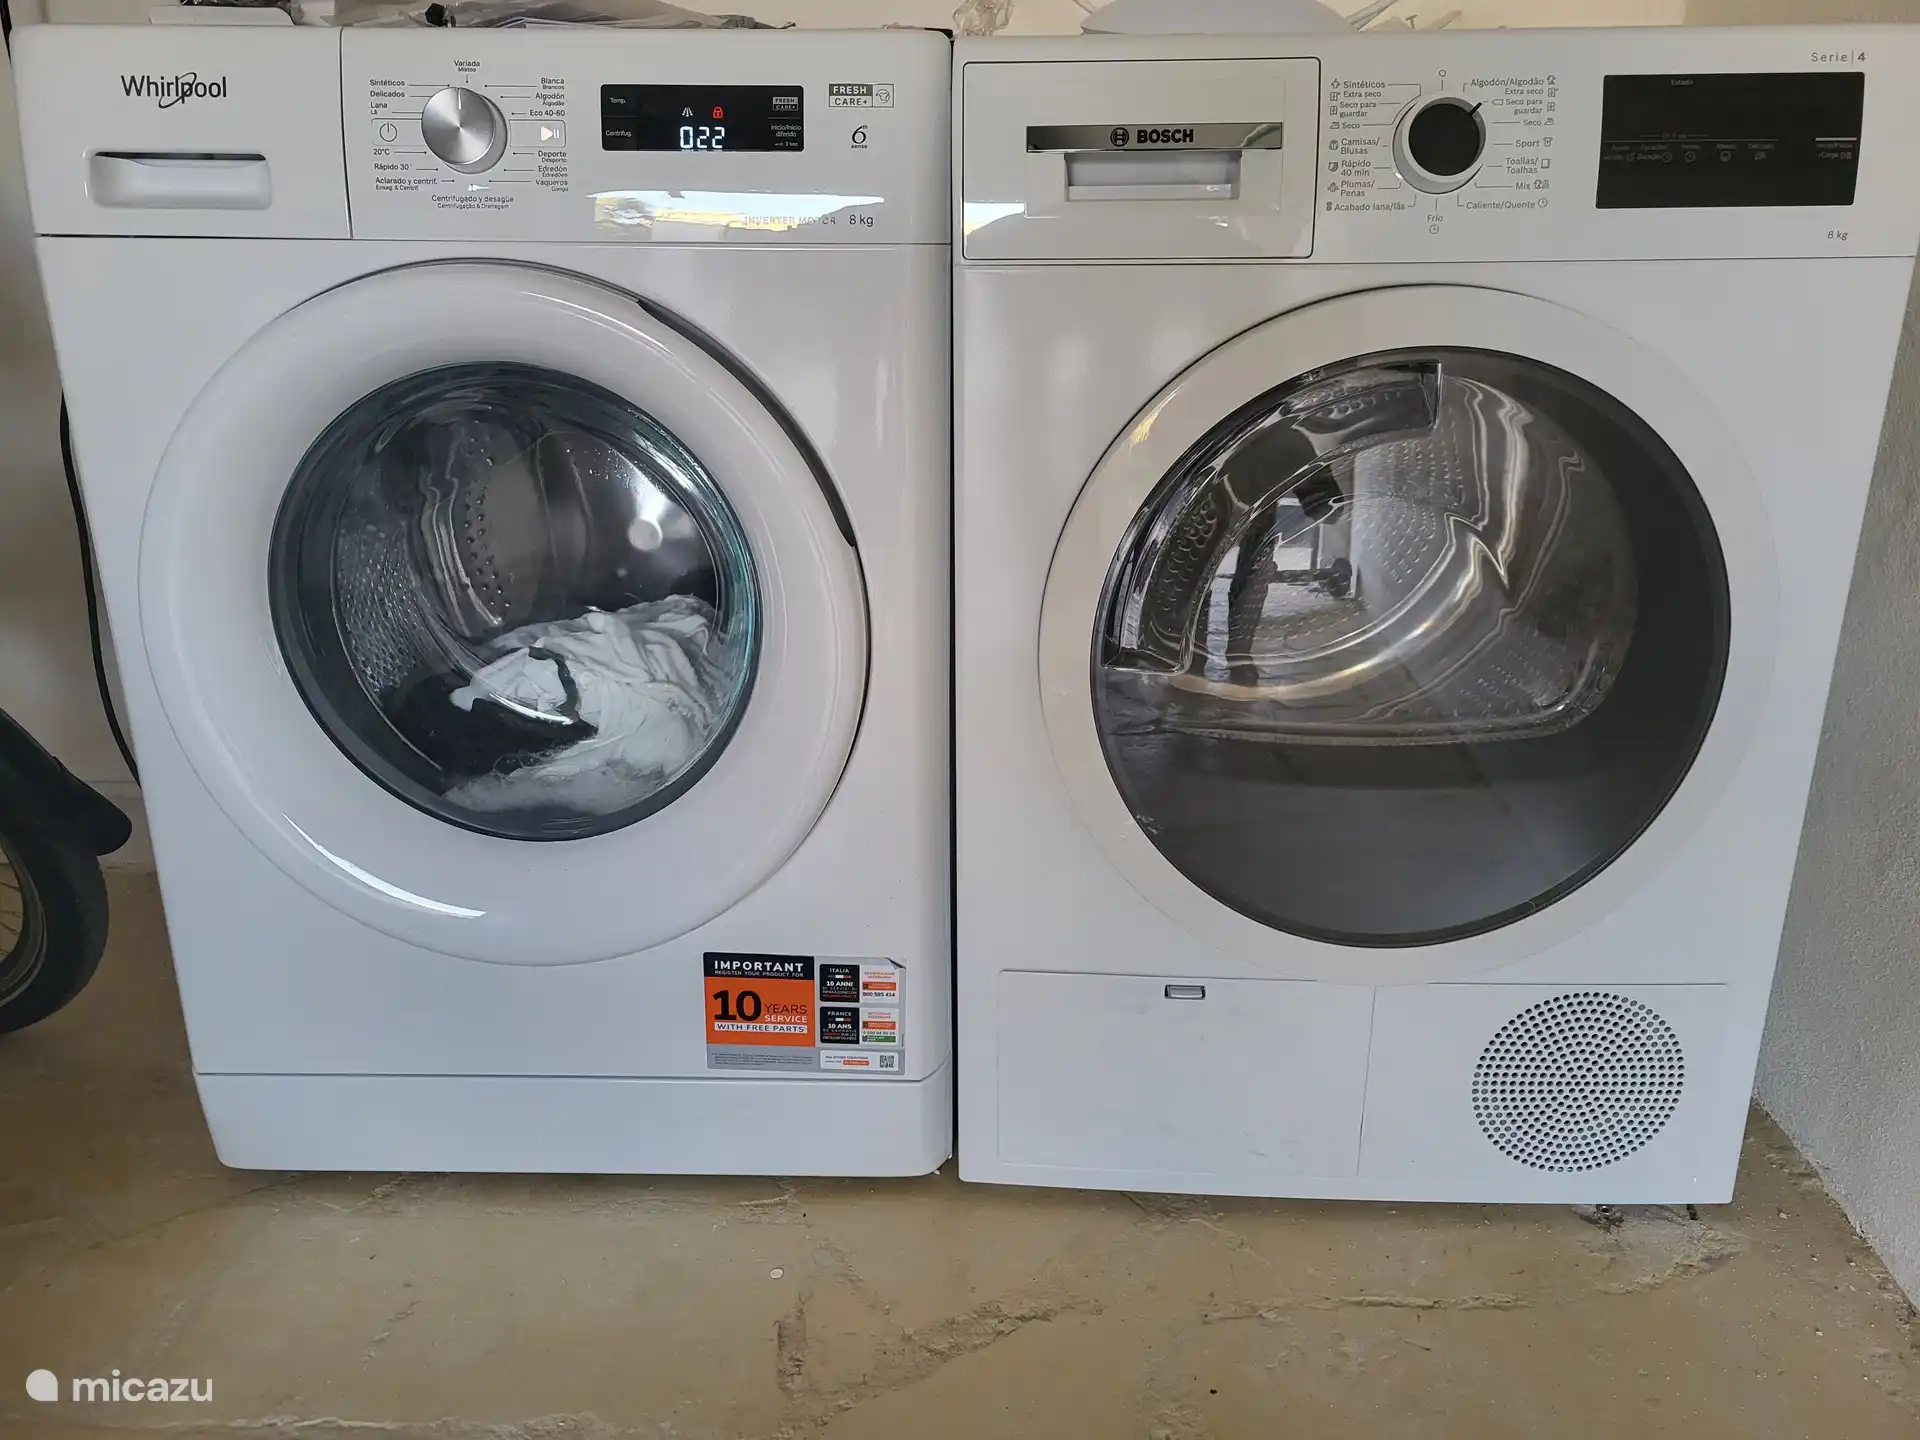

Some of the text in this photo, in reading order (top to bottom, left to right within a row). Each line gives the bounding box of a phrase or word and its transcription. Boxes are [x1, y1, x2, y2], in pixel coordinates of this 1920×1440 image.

[1470, 78, 1544, 87] Algodón/Algodão
[121, 72, 227, 108] Whirlpool
[834, 86, 867, 94] FRESH
[1136, 129, 1194, 143] BOSCH
[1341, 137, 1380, 147] Camisas/
[1516, 140, 1540, 148] Sport
[1341, 160, 1371, 169] Rápido
[1506, 157, 1539, 165] Toallas/
[374, 163, 398, 171] Rápido
[536, 179, 568, 187] Vaqueros
[1341, 180, 1375, 188] Plumas/
[432, 194, 478, 203] Centrifugado
[1466, 201, 1535, 210] Caliente/Quente
[745, 216, 794, 225] INVERTER
[848, 215, 856, 225] 8
[860, 214, 874, 227] kg
[1828, 230, 1848, 241] 8 kg
[714, 960, 803, 972] IMPORTANT
[713, 990, 762, 1021] 10
[764, 1004, 807, 1014] YEARS
[764, 1014, 807, 1023] SERVICE
